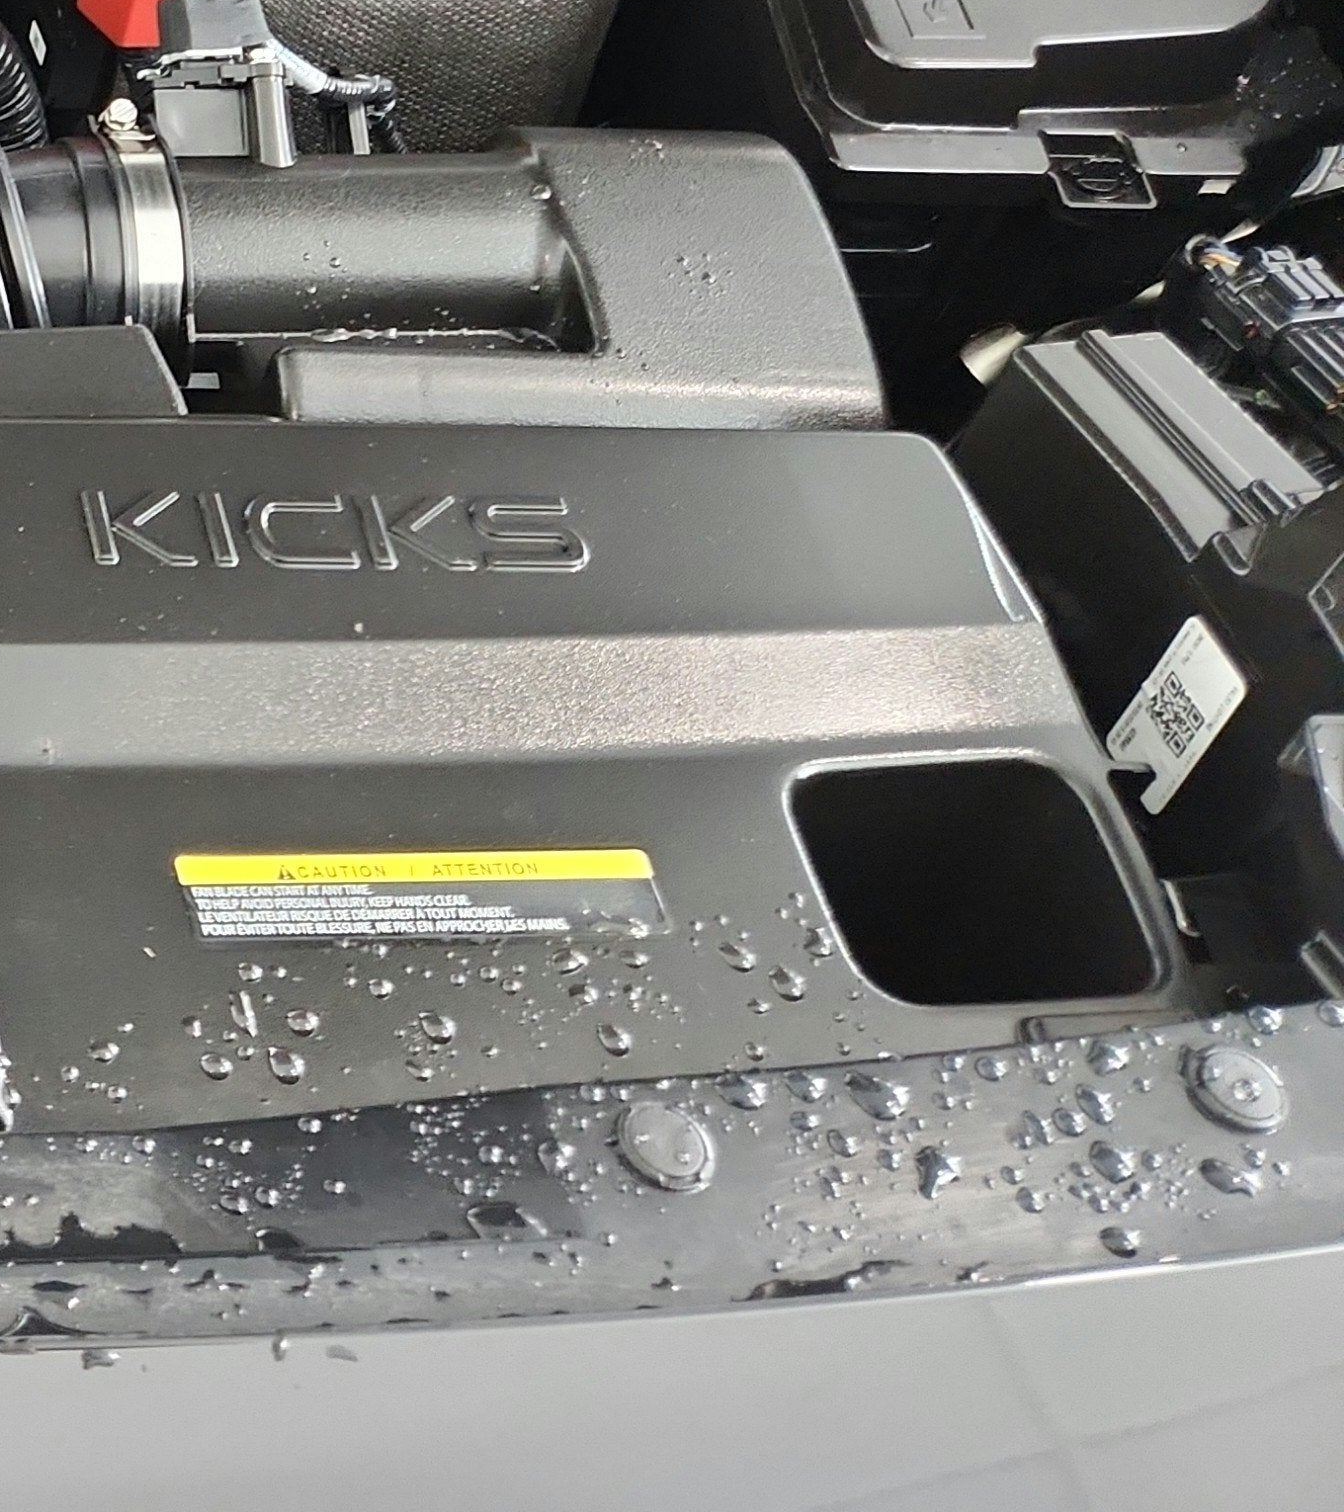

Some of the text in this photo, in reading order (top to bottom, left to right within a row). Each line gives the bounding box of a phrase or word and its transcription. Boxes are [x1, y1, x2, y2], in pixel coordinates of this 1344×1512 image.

[81, 490, 591, 573] KICKS
[297, 864, 387, 879] CAUTION
[432, 861, 539, 877] ATTENTION
